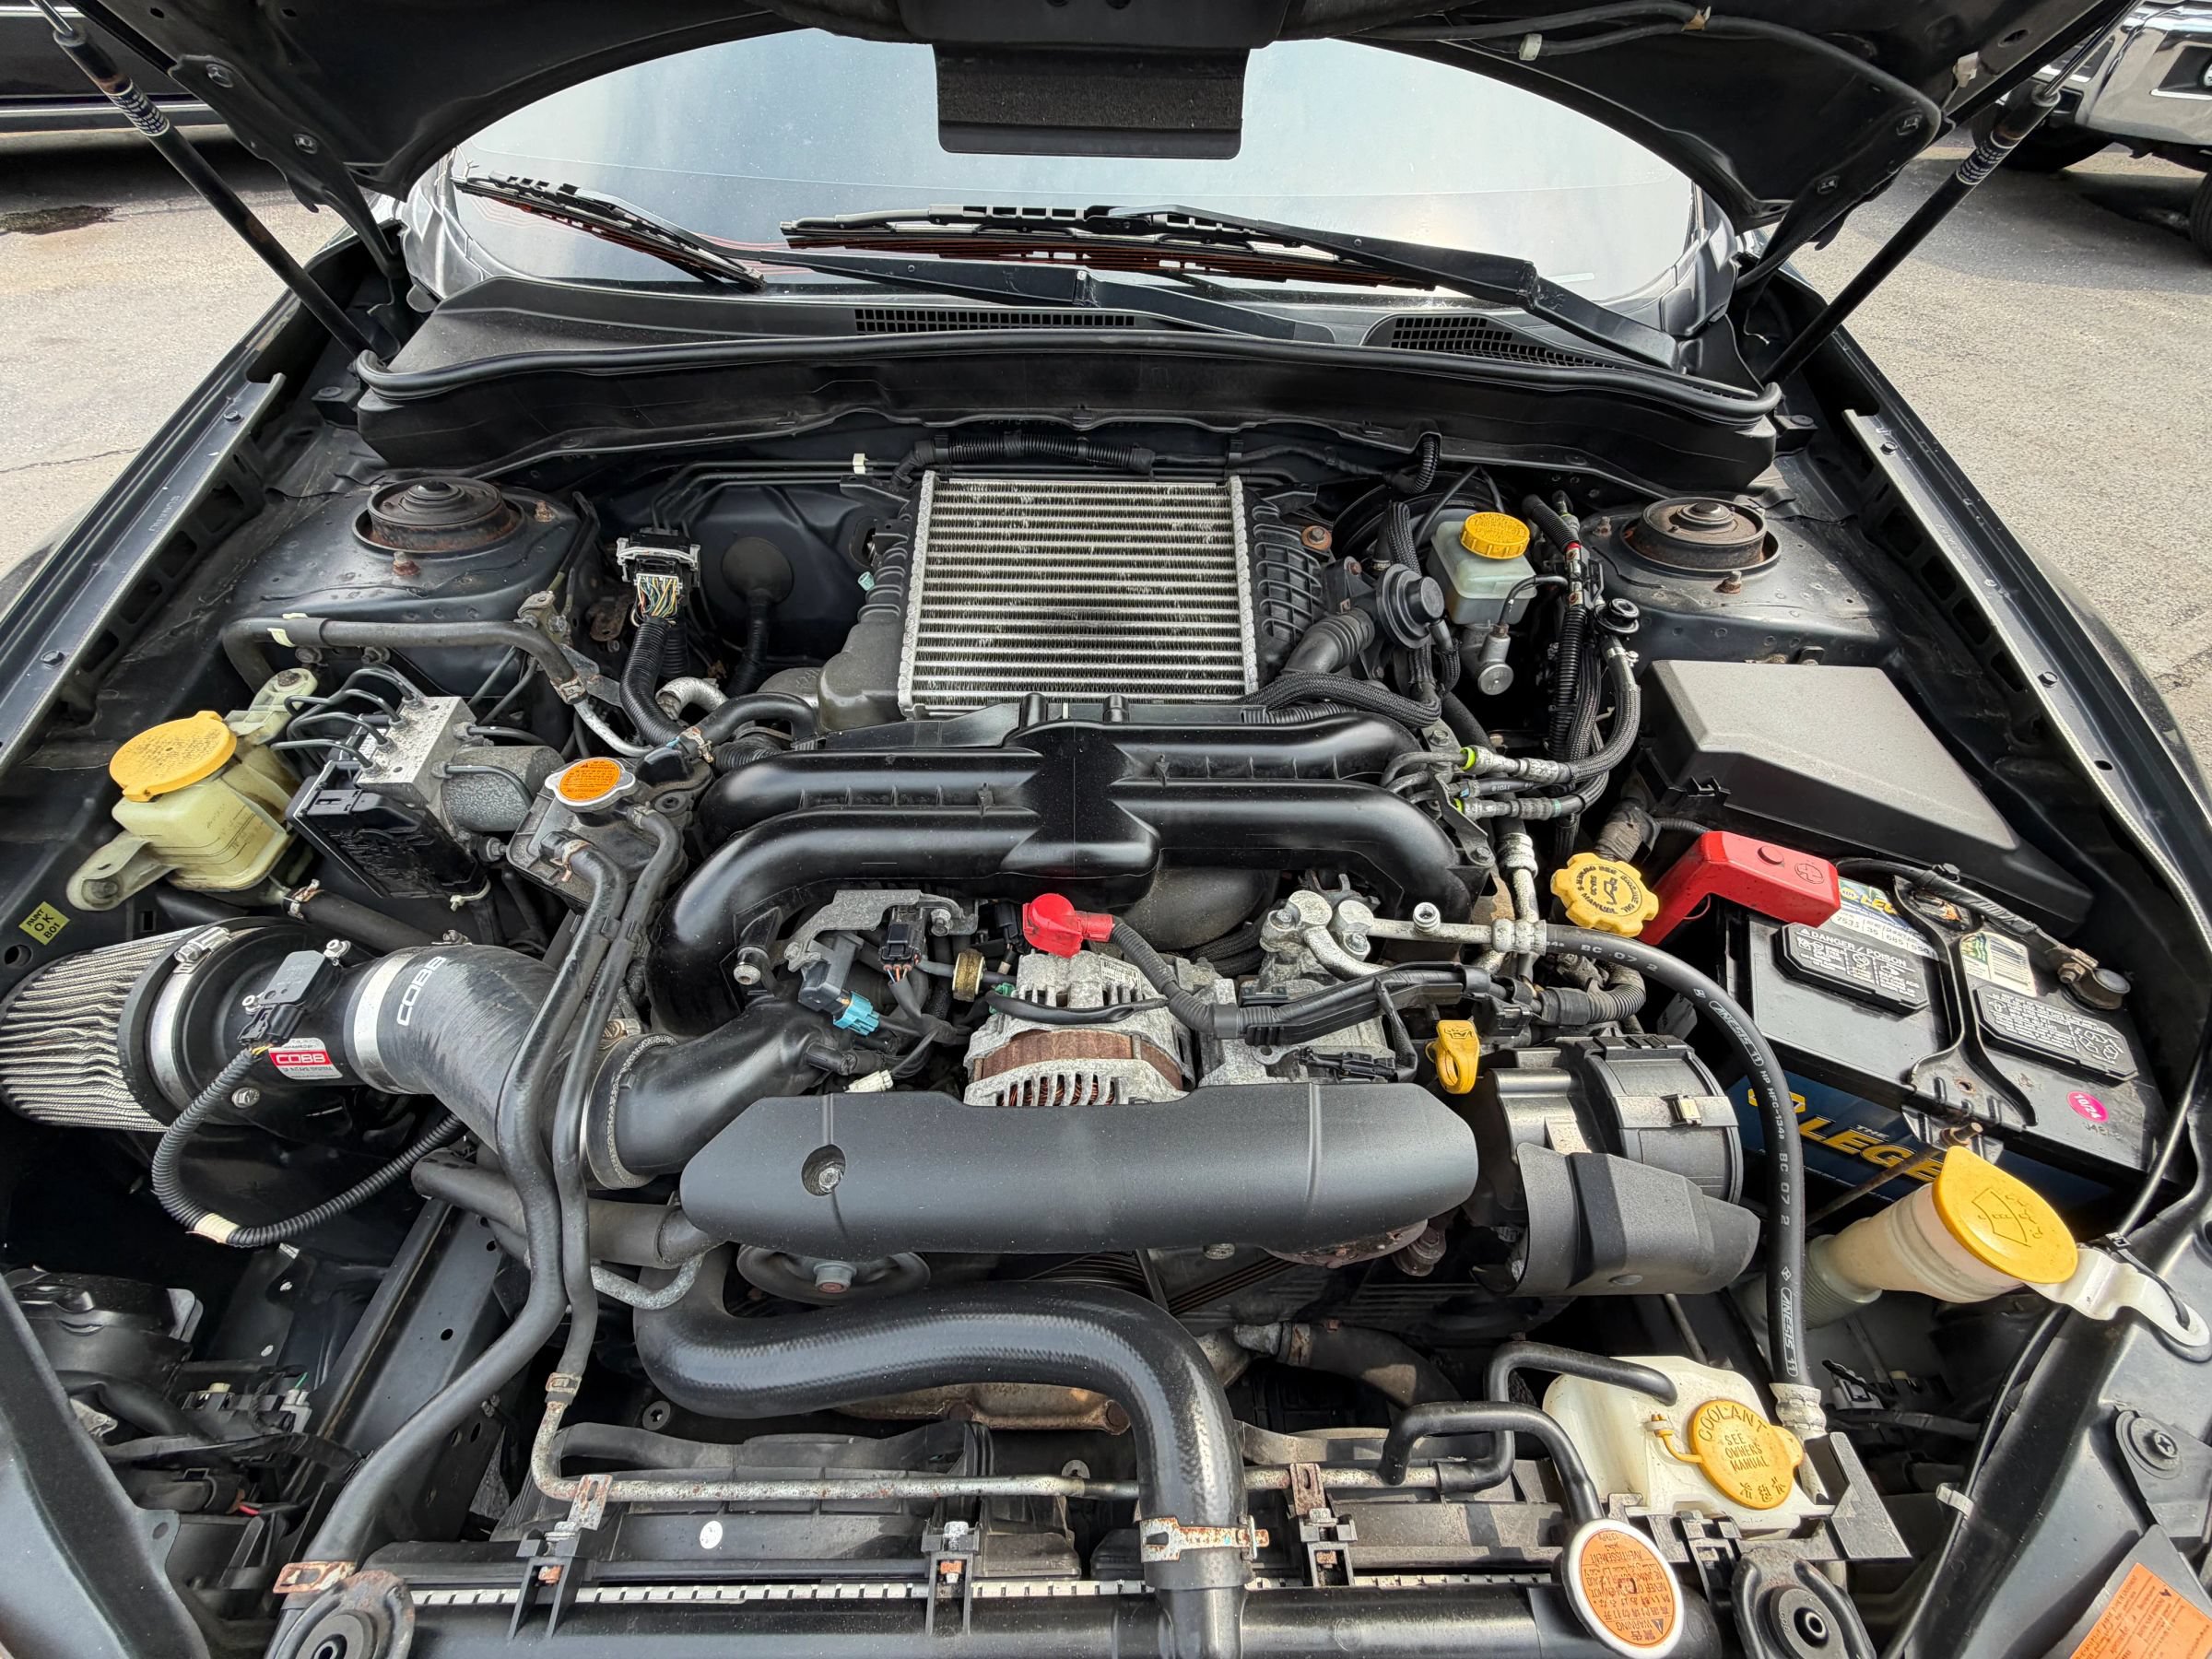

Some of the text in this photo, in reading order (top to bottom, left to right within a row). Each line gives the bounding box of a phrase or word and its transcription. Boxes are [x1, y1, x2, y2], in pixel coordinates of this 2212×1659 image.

[1580, 944, 1660, 972] BC 07 2
[1809, 931, 1855, 951] DANGER
[1866, 947, 1907, 968] POISON
[396, 956, 447, 1027] COBB
[276, 1053, 326, 1065] COBB
[1759, 1070, 1771, 1087] HP
[2074, 1094, 2102, 1119] 10/24
[1856, 1124, 1889, 1138] THE
[1778, 1152, 1790, 1172] BC
[1780, 1182, 1791, 1206] 07
[1780, 1215, 1791, 1227] 2
[1699, 1406, 1767, 1441] COOLANT
[1724, 1432, 1746, 1445] SEE
[1730, 1456, 1770, 1474] MANUAL
[1616, 1618, 1653, 1631] WARNING
